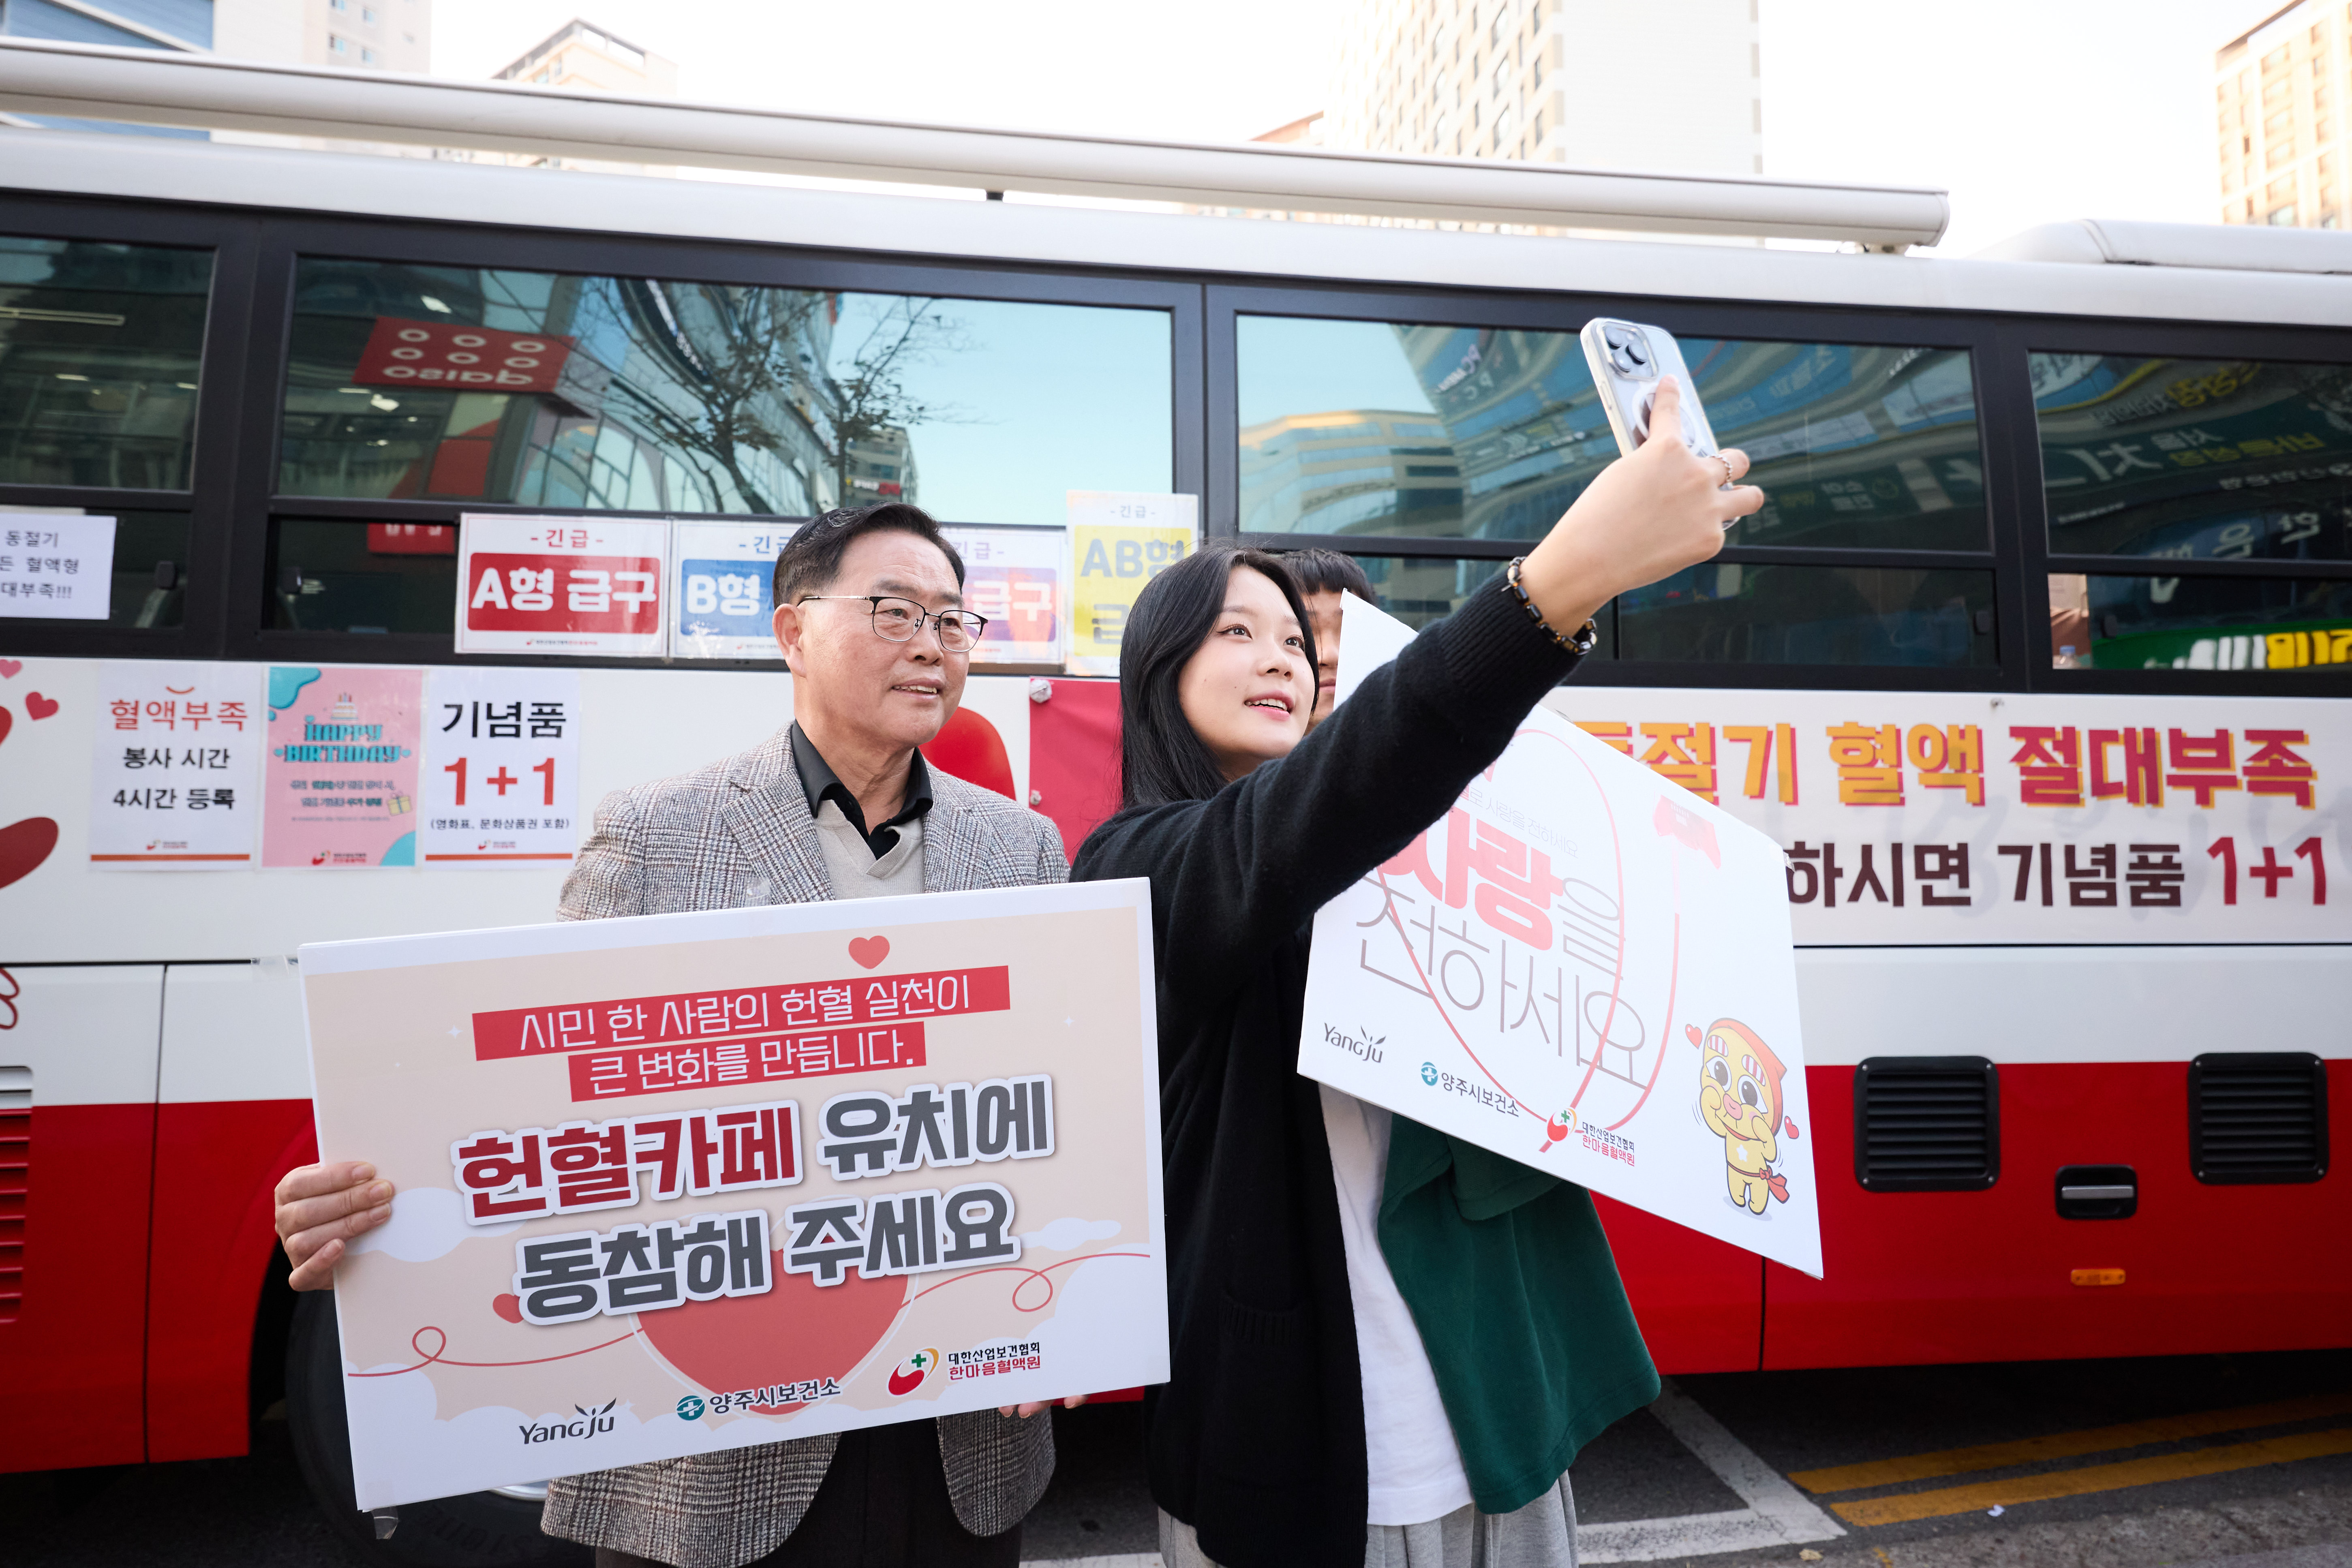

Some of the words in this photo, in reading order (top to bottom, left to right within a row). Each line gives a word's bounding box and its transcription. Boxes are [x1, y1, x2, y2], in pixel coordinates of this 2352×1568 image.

[5, 530, 59, 548] 동절기
[546, 529, 589, 548] 긴급
[27, 557, 79, 575] 혈액형
[471, 567, 554, 611] A형
[567, 569, 657, 613] 급구
[687, 573, 760, 616] B형
[971, 580, 1053, 622] 급구
[110, 700, 248, 731] 혈액부족
[304, 723, 383, 742] HAPPY
[442, 701, 567, 739] 기념품
[123, 747, 172, 769] 봉사
[181, 747, 231, 770] 시간
[285, 744, 401, 763] BIRTHDAY
[1825, 721, 1986, 806] 혈액
[2008, 725, 2318, 811] 절대부족
[113, 788, 176, 810] 4시간
[186, 788, 236, 810] 등록
[444, 757, 555, 806] 1+1
[480, 819, 538, 830] 문화상품권
[542, 818, 569, 830] 포함)
[1485, 797, 1525, 831] 사랑을
[1527, 817, 1579, 859] 전하세요
[1997, 842, 2185, 908] 기념품
[2206, 836, 2327, 906] 1+1
[1355, 875, 1651, 1092] 전하세요
[520, 1010, 595, 1051] 시민
[608, 1004, 647, 1043] 한
[659, 993, 768, 1037] 사람의
[781, 984, 853, 1027] 헌혈
[865, 975, 969, 1017] 실천이
[590, 1057, 627, 1095] 큰
[638, 1044, 749, 1089] 변화를
[761, 1030, 914, 1076] 만듭니다.
[1441, 1071, 1519, 1118] 양주시보건소
[458, 1106, 796, 1218] 헌혈카페
[822, 1081, 1047, 1175] 유치에
[1582, 1121, 1635, 1153] 대한산업보건협회
[1582, 1134, 1635, 1167] 한마음혈액원
[520, 1215, 766, 1319] 동참해
[790, 1188, 1014, 1281] 주세요
[948, 1341, 1041, 1365] 대한산업보건협회
[948, 1354, 1041, 1382] 한마음혈액원
[709, 1378, 842, 1414] 양주시보건소
